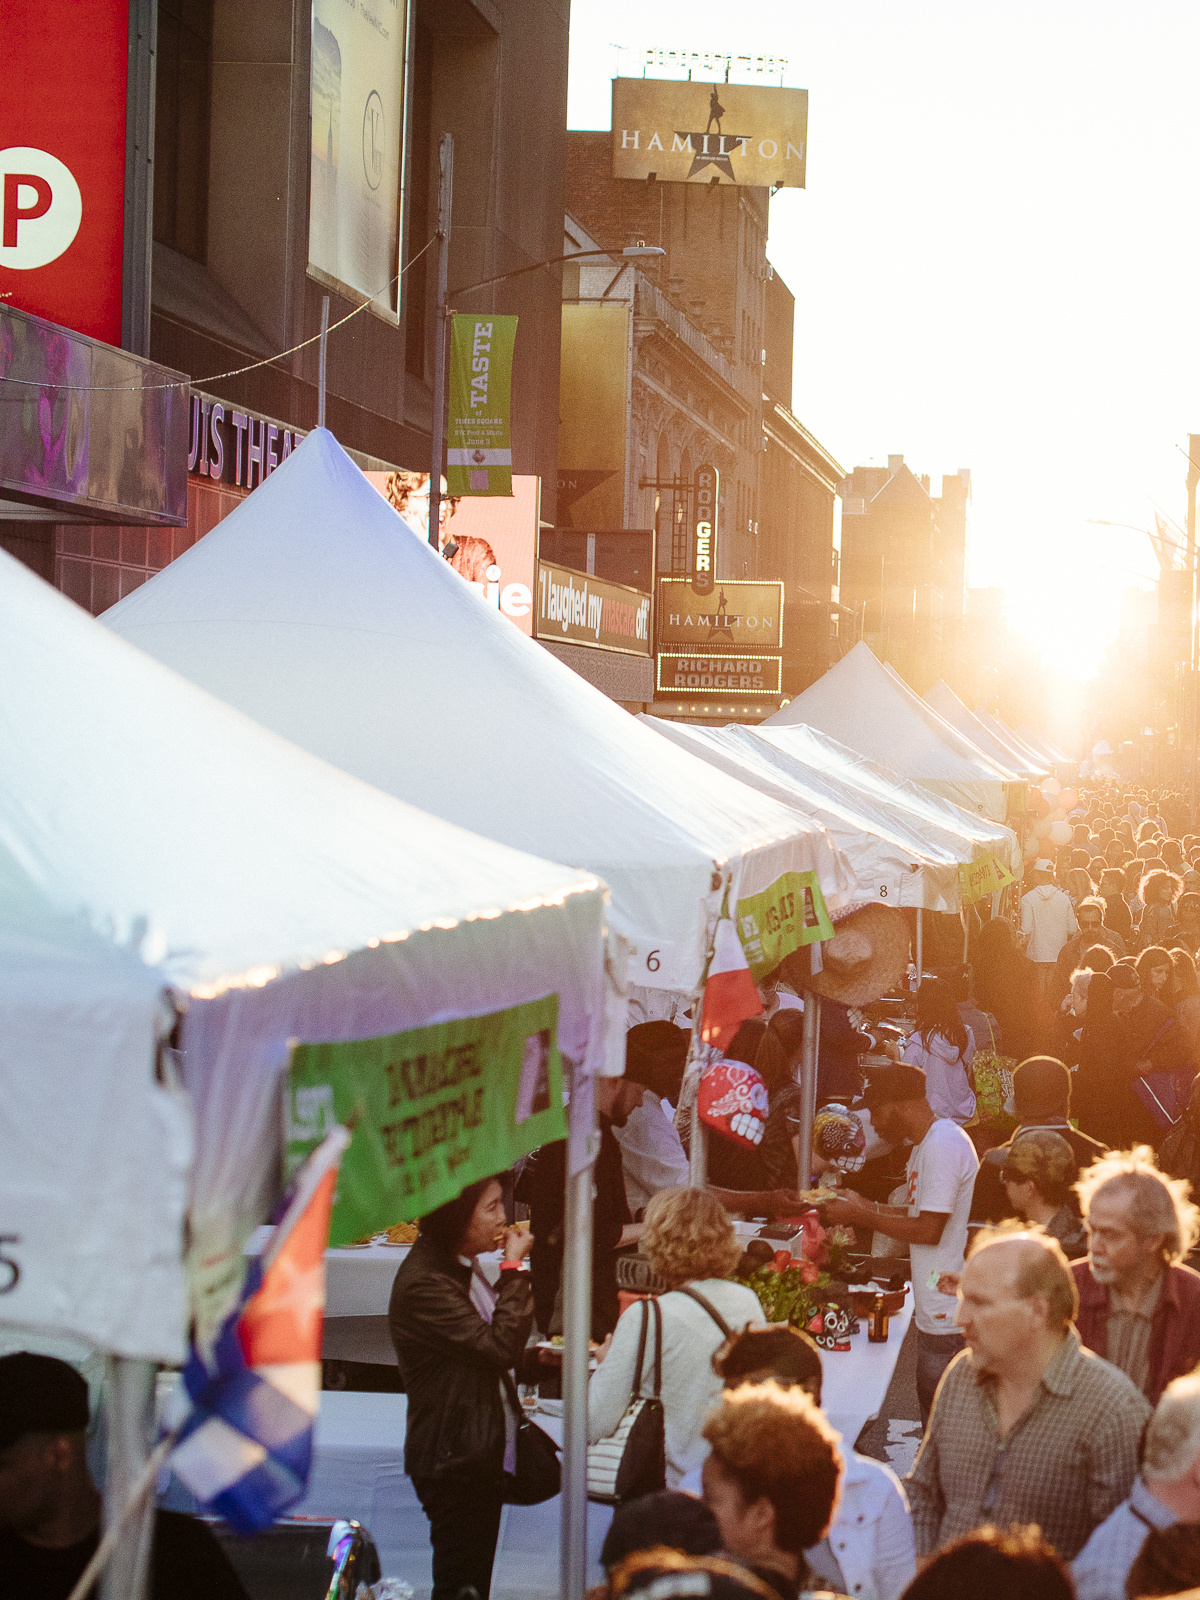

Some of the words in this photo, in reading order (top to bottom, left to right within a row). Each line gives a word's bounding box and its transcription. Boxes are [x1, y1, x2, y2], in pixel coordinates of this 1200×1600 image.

[621, 129, 804, 160] HAMILTON
[470, 322, 493, 408] TASTE
[696, 472, 712, 588] RODGERS
[547, 570, 588, 632] laughed
[588, 592, 603, 640] my
[669, 613, 774, 629] HAMILTON
[677, 660, 762, 674] RICHARD
[674, 673, 764, 688] RODGERS
[978, 804, 983, 812] 9
[880, 885, 888, 898] 8
[646, 950, 661, 972] 6
